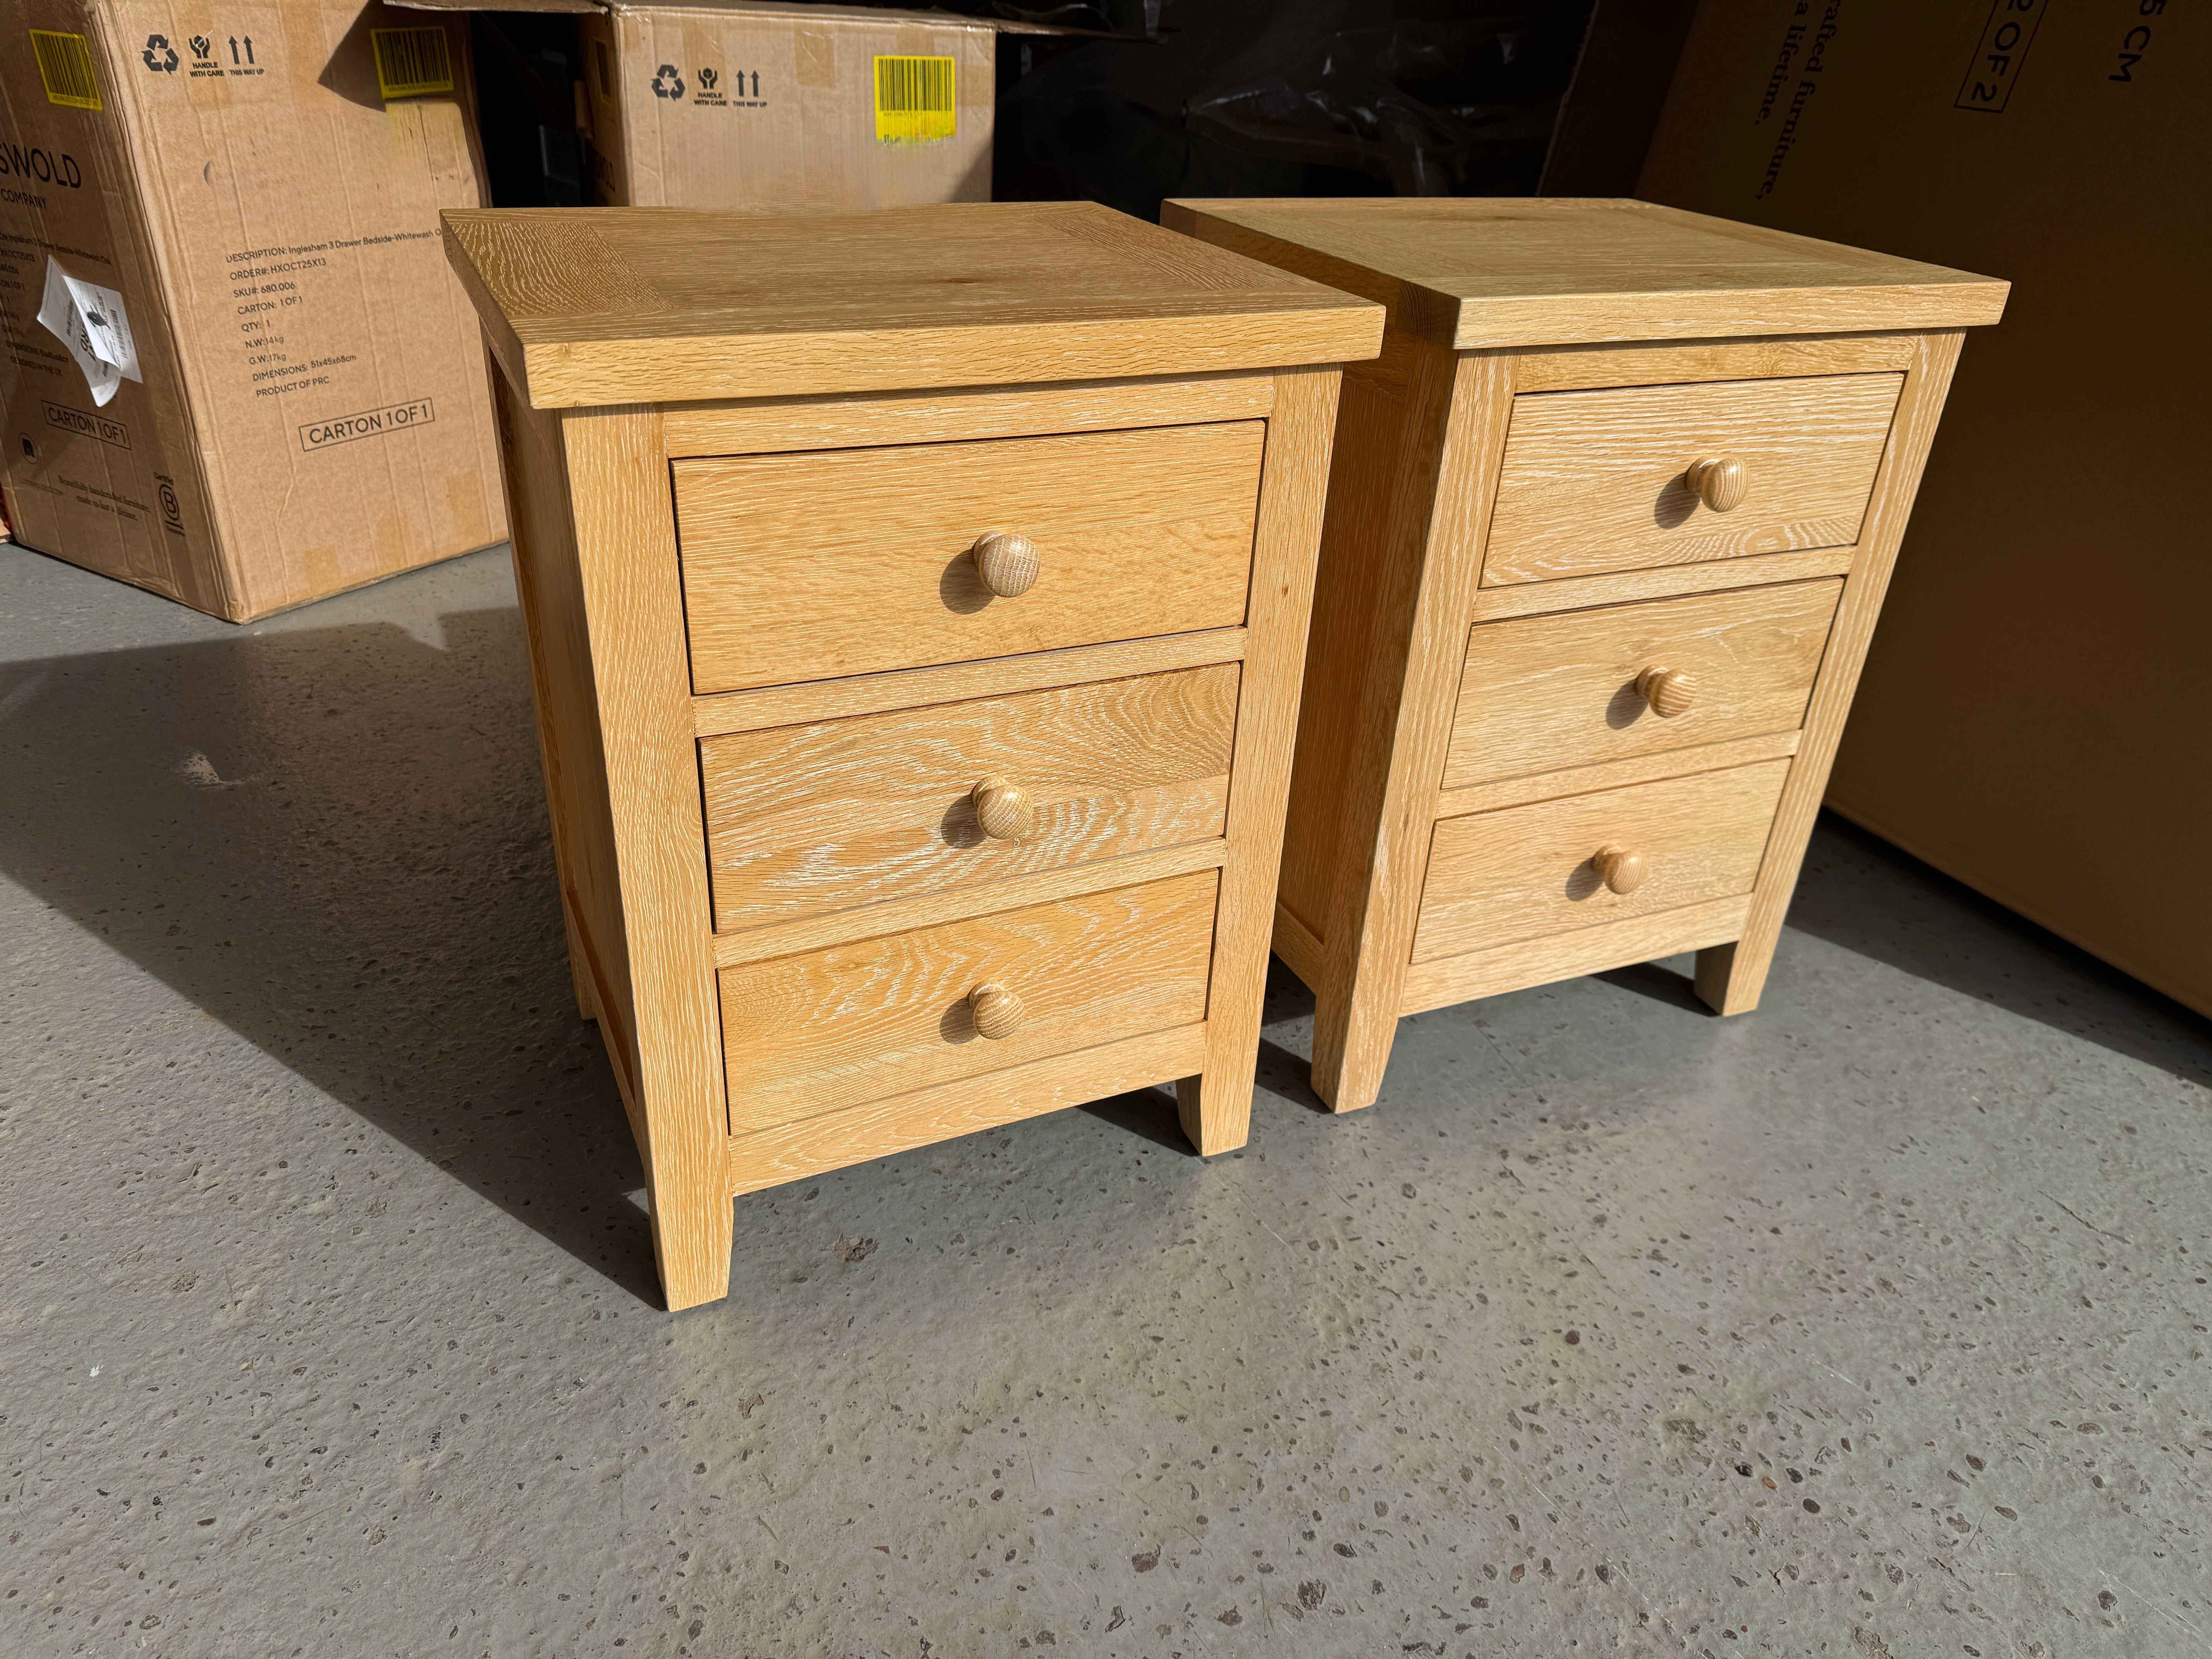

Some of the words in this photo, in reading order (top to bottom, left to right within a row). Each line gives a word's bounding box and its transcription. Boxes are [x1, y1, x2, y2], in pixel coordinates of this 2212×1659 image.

[1794, 1, 1809, 16] a
[1987, 21, 2020, 76] OF
[2108, 26, 2151, 82] CM
[1755, 24, 1807, 125] lifetime.
[1971, 81, 1997, 101] 2
[1754, 79, 1816, 200] furniture,
[1, 188, 47, 210] COMPANY
[226, 247, 288, 263] DESCRIPTION:
[289, 243, 328, 255] Inglesham
[329, 241, 334, 249] 3
[335, 240, 362, 249] Drawer
[363, 229, 434, 246] Bedside-Whitewash
[230, 268, 270, 280] ORDER#:
[270, 258, 326, 274] HXOCT25X13
[233, 287, 259, 298] SKU#:
[261, 282, 295, 294] 680.006
[237, 301, 277, 314] CARTON:
[285, 296, 297, 306] OF
[241, 321, 262, 332] QTY:
[266, 319, 270, 328] 1
[252, 364, 309, 381] DIMENSIONS:
[311, 354, 357, 368] 51x45x68cm
[256, 382, 297, 397] PRODUCT
[299, 380, 311, 389] OF
[313, 376, 330, 386] PRC
[48, 407, 96, 434] CARTON
[97, 421, 103, 436] 1
[103, 423, 118, 440] OF
[120, 429, 126, 444] 1
[309, 414, 382, 444] CARTON
[386, 411, 393, 426] 1
[395, 406, 417, 424] OF
[421, 404, 428, 418] 1
